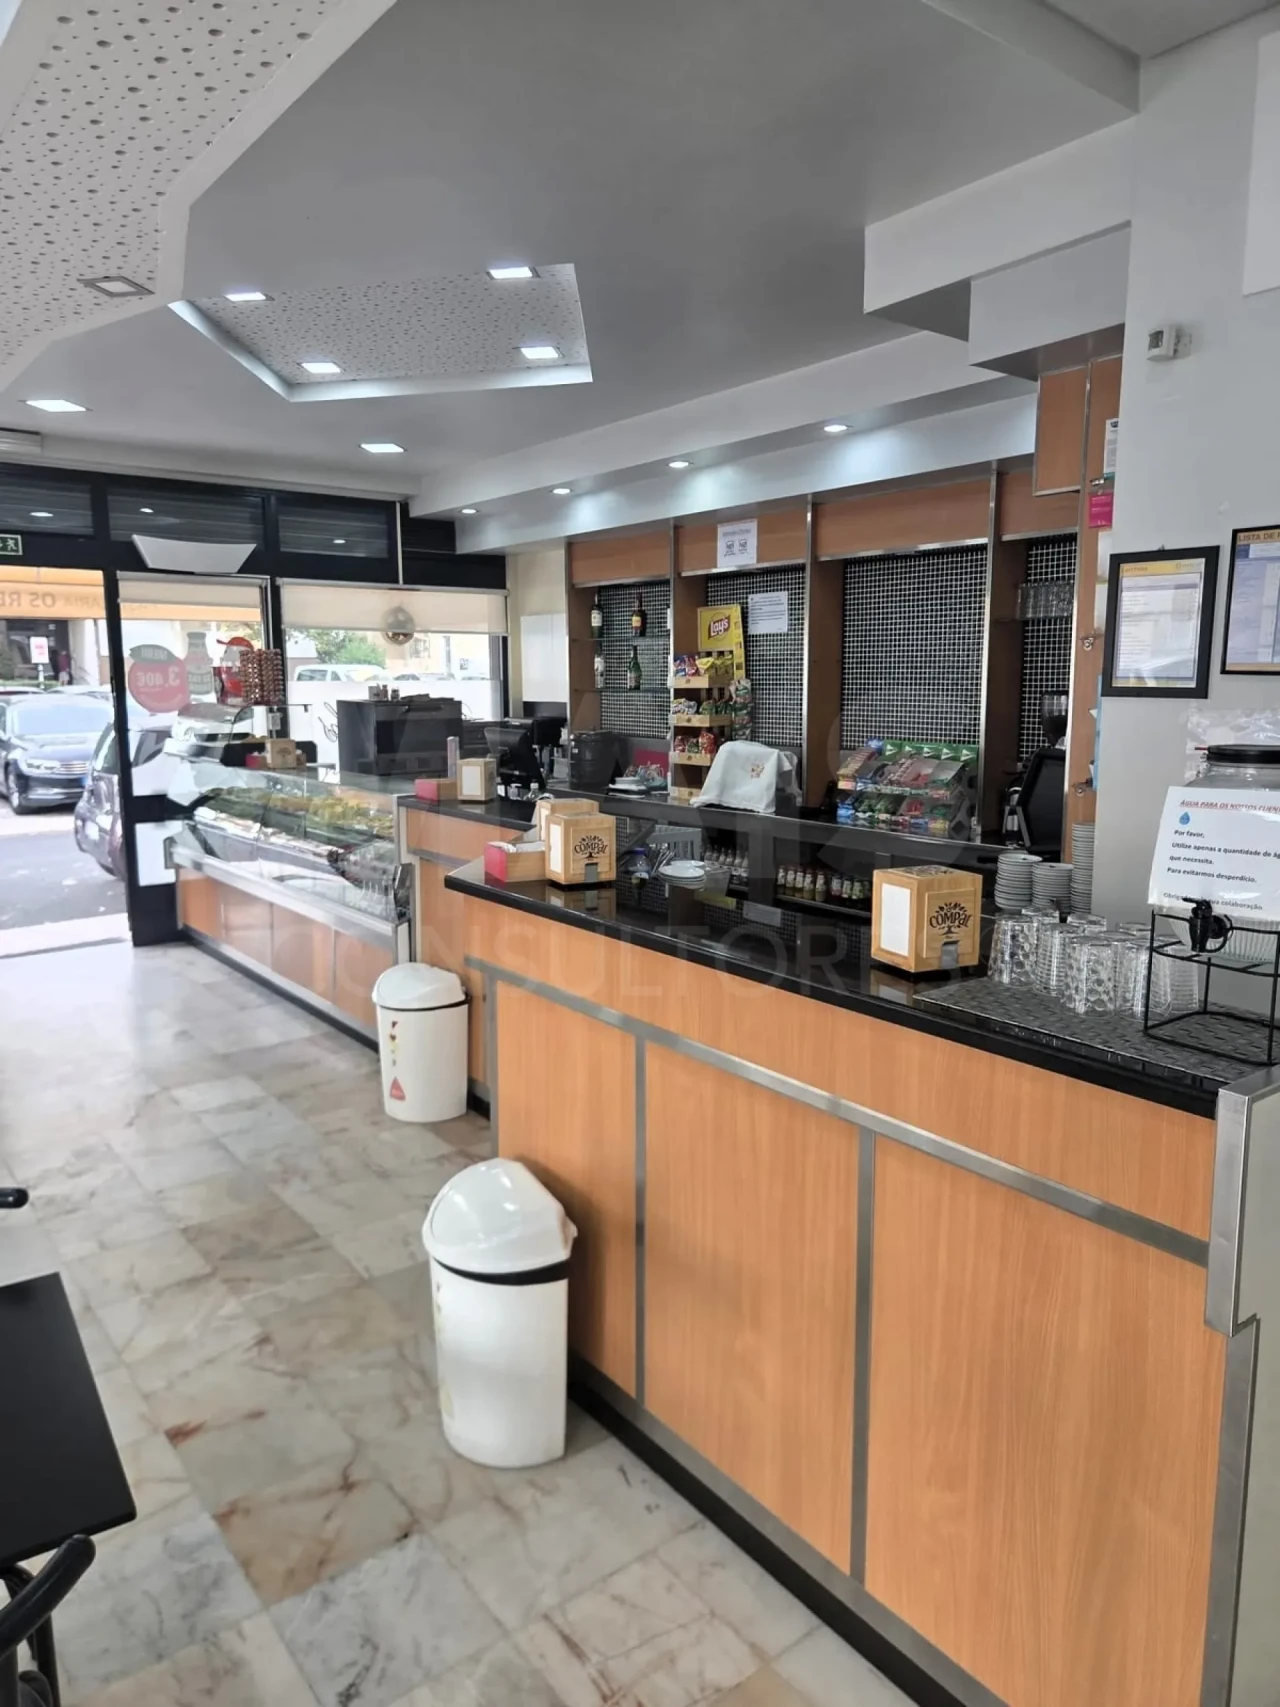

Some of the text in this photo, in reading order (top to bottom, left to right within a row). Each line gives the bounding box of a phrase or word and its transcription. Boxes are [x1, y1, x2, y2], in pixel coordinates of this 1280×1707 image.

[1238, 533, 1261, 542] LISTA
[1263, 531, 1275, 540] DE
[1186, 830, 1205, 838] favor,
[1193, 844, 1216, 852] apenas
[1223, 847, 1261, 857] quantidade
[1262, 849, 1272, 857] de
[1183, 856, 1214, 865] necessita.
[1167, 866, 1182, 874] Para
[1182, 867, 1215, 878] evitarmos
